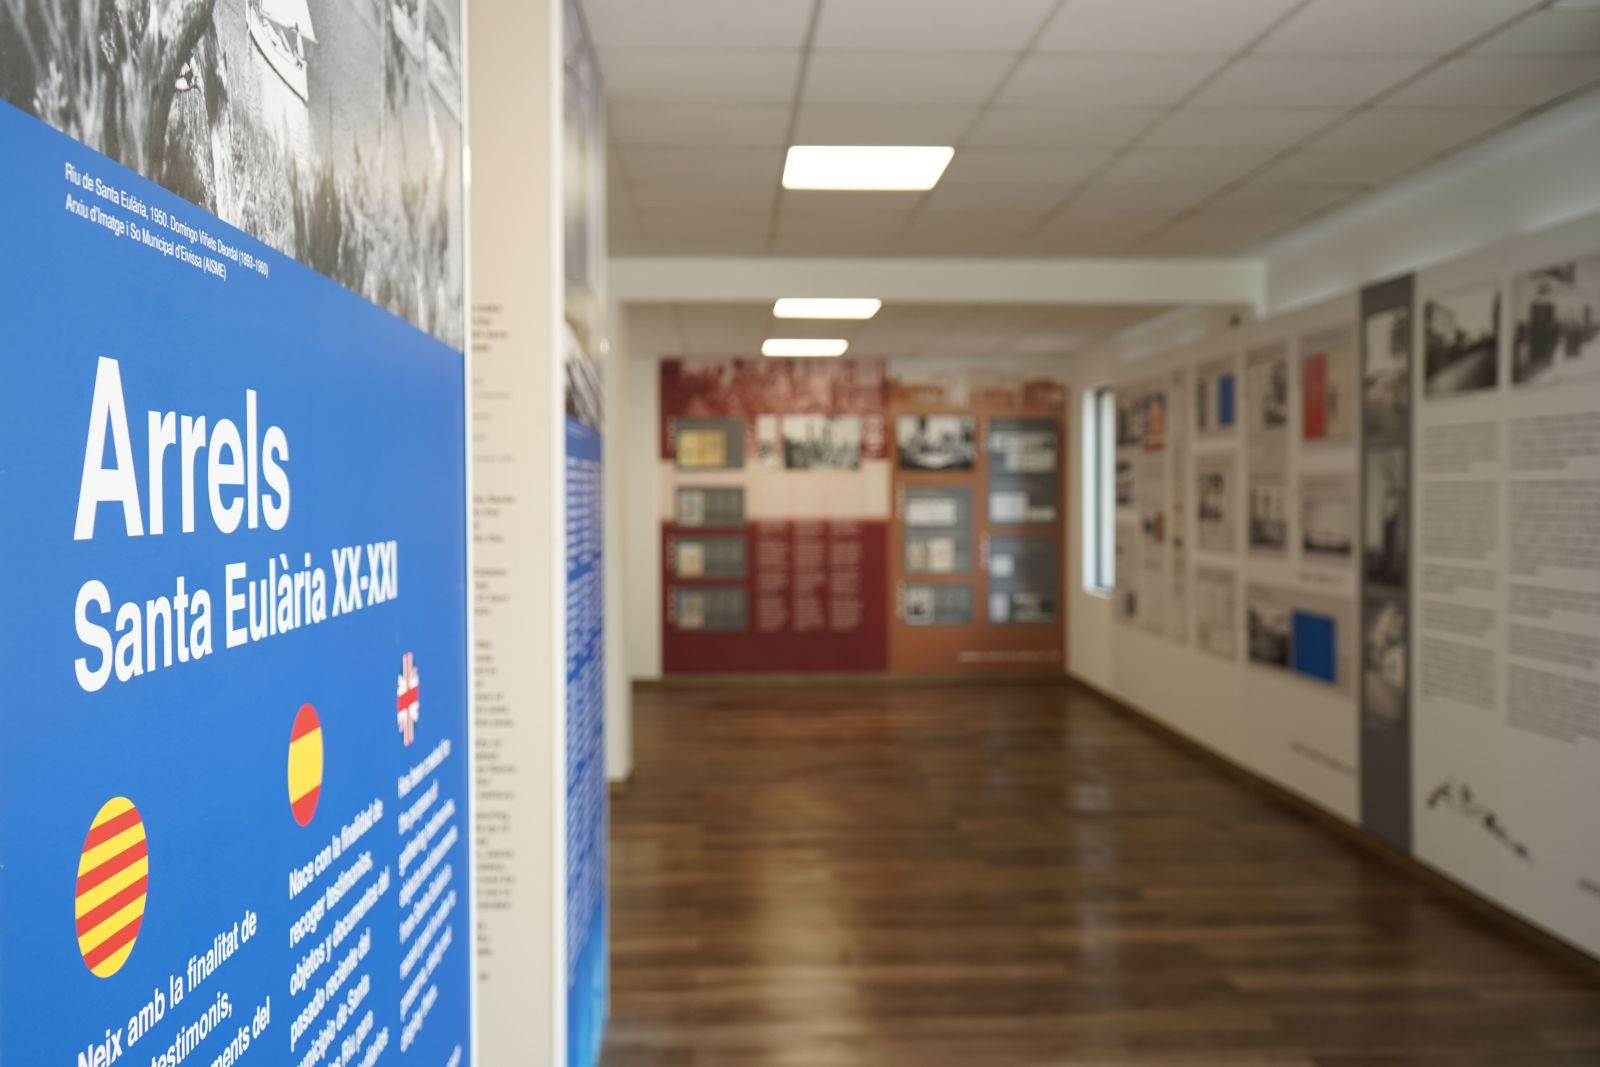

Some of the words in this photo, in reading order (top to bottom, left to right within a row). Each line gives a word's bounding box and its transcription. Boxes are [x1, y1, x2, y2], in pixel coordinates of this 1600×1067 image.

[65, 162, 81, 186] Riu
[82, 173, 94, 192] de
[96, 178, 119, 204] Santa
[121, 190, 149, 221] Eulària,
[151, 206, 169, 228] 1950.
[170, 215, 198, 244] Domingo
[65, 193, 89, 219] Arxiu
[90, 206, 125, 236] d'Imatge
[125, 220, 130, 236] i
[130, 223, 141, 241] So
[142, 228, 174, 256] Municipal
[73, 356, 290, 540] Arrels
[74, 576, 213, 692] Santa
[225, 552, 327, 648] Eulària
[332, 540, 398, 617] XX-XXI
[289, 861, 314, 900] Nace
[315, 845, 332, 877] con
[331, 835, 341, 860] la
[289, 895, 325, 949] recoger
[78, 1027, 122, 1067] Neix
[127, 987, 166, 1047] amb
[170, 974, 184, 1009] la
[187, 922, 239, 992] finalitat
[241, 909, 257, 943] de
[290, 942, 325, 996] objetos
[325, 933, 333, 963] y
[252, 995, 271, 1040] del
[290, 987, 325, 1053] pasado
[297, 1019, 335, 1067] unicipio
